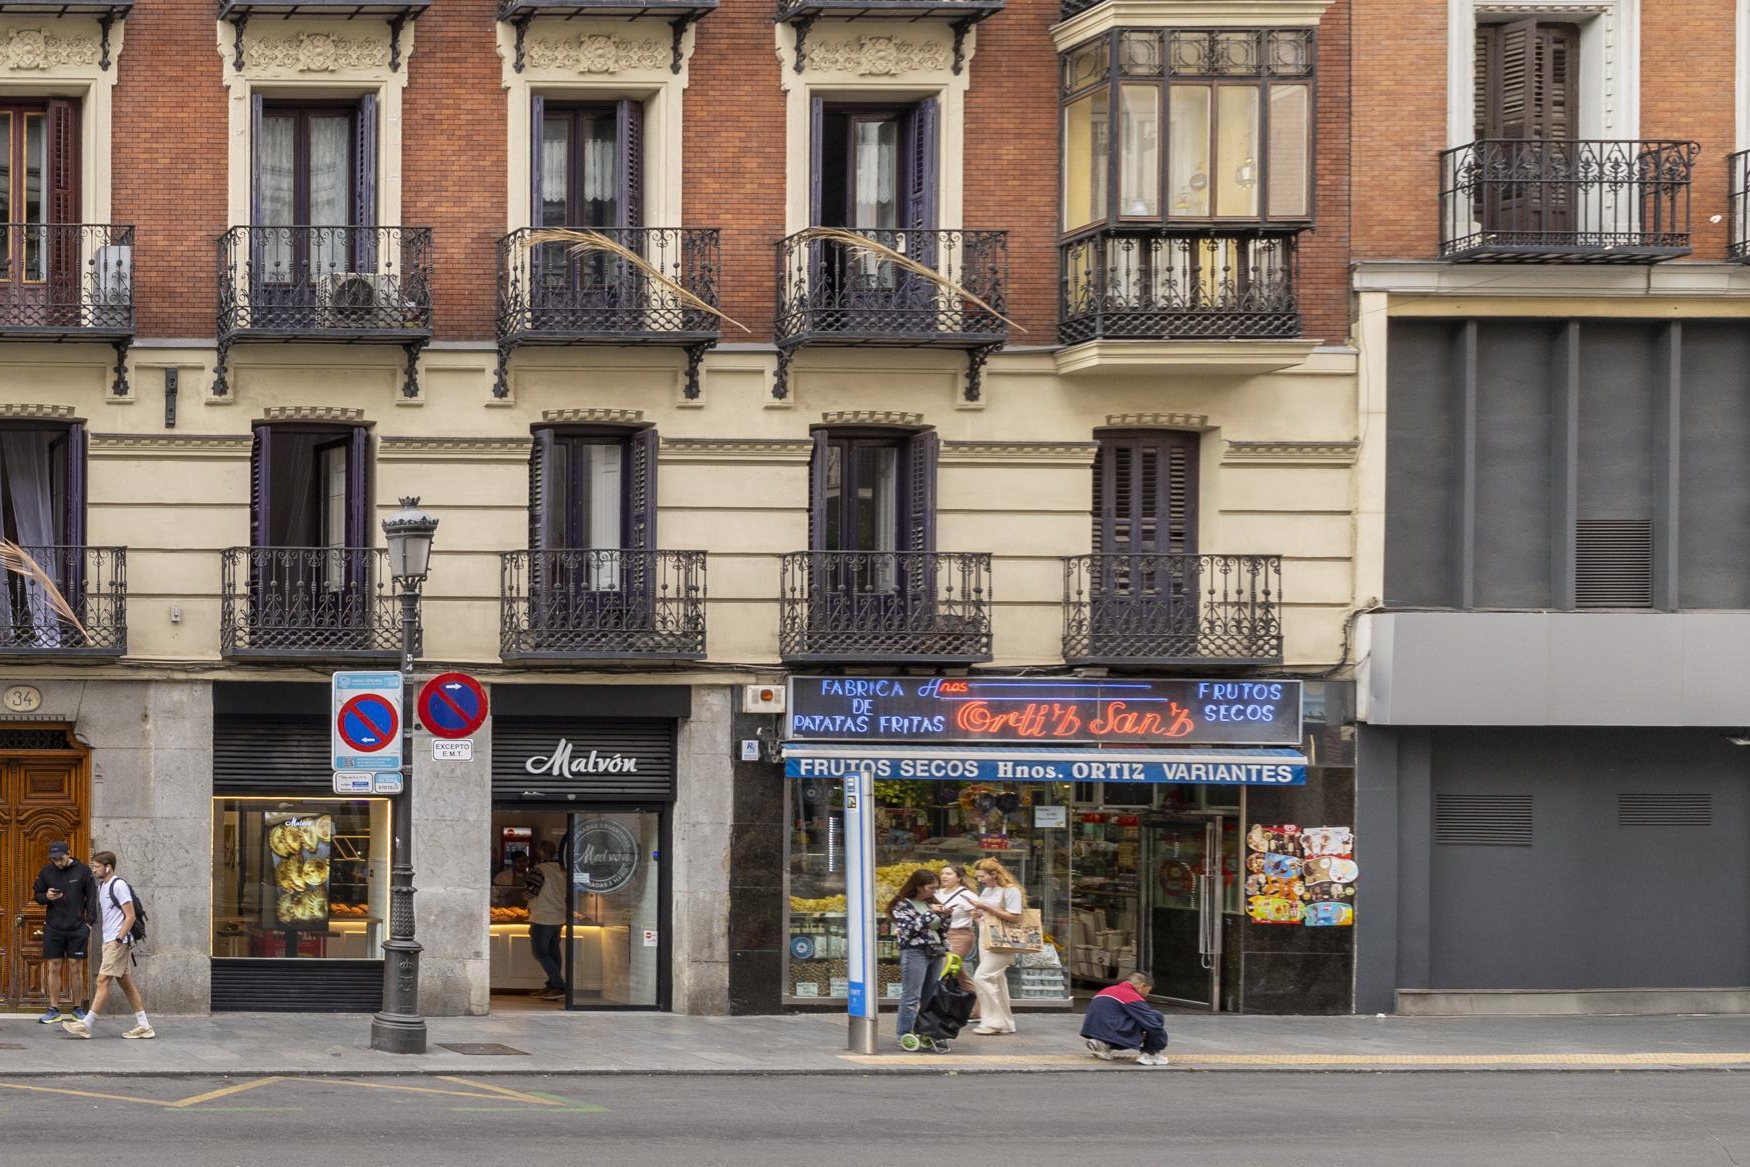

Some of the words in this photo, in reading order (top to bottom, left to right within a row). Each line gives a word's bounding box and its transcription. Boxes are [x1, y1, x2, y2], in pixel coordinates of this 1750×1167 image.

[821, 679, 904, 697] FABRICA
[1198, 682, 1283, 700] FRUTOS
[13, 691, 33, 706] 34
[852, 698, 874, 716] DE
[1204, 704, 1276, 722] SECOS
[793, 715, 869, 733] PATATAS
[879, 715, 946, 734] FRITAS
[525, 738, 638, 778] Malvón
[800, 758, 891, 777] FRUTOS
[900, 760, 979, 777] SECOS
[997, 762, 1063, 779] Hnos.
[1072, 762, 1146, 780] ORTIZ
[1162, 763, 1293, 783] VARIANTES
